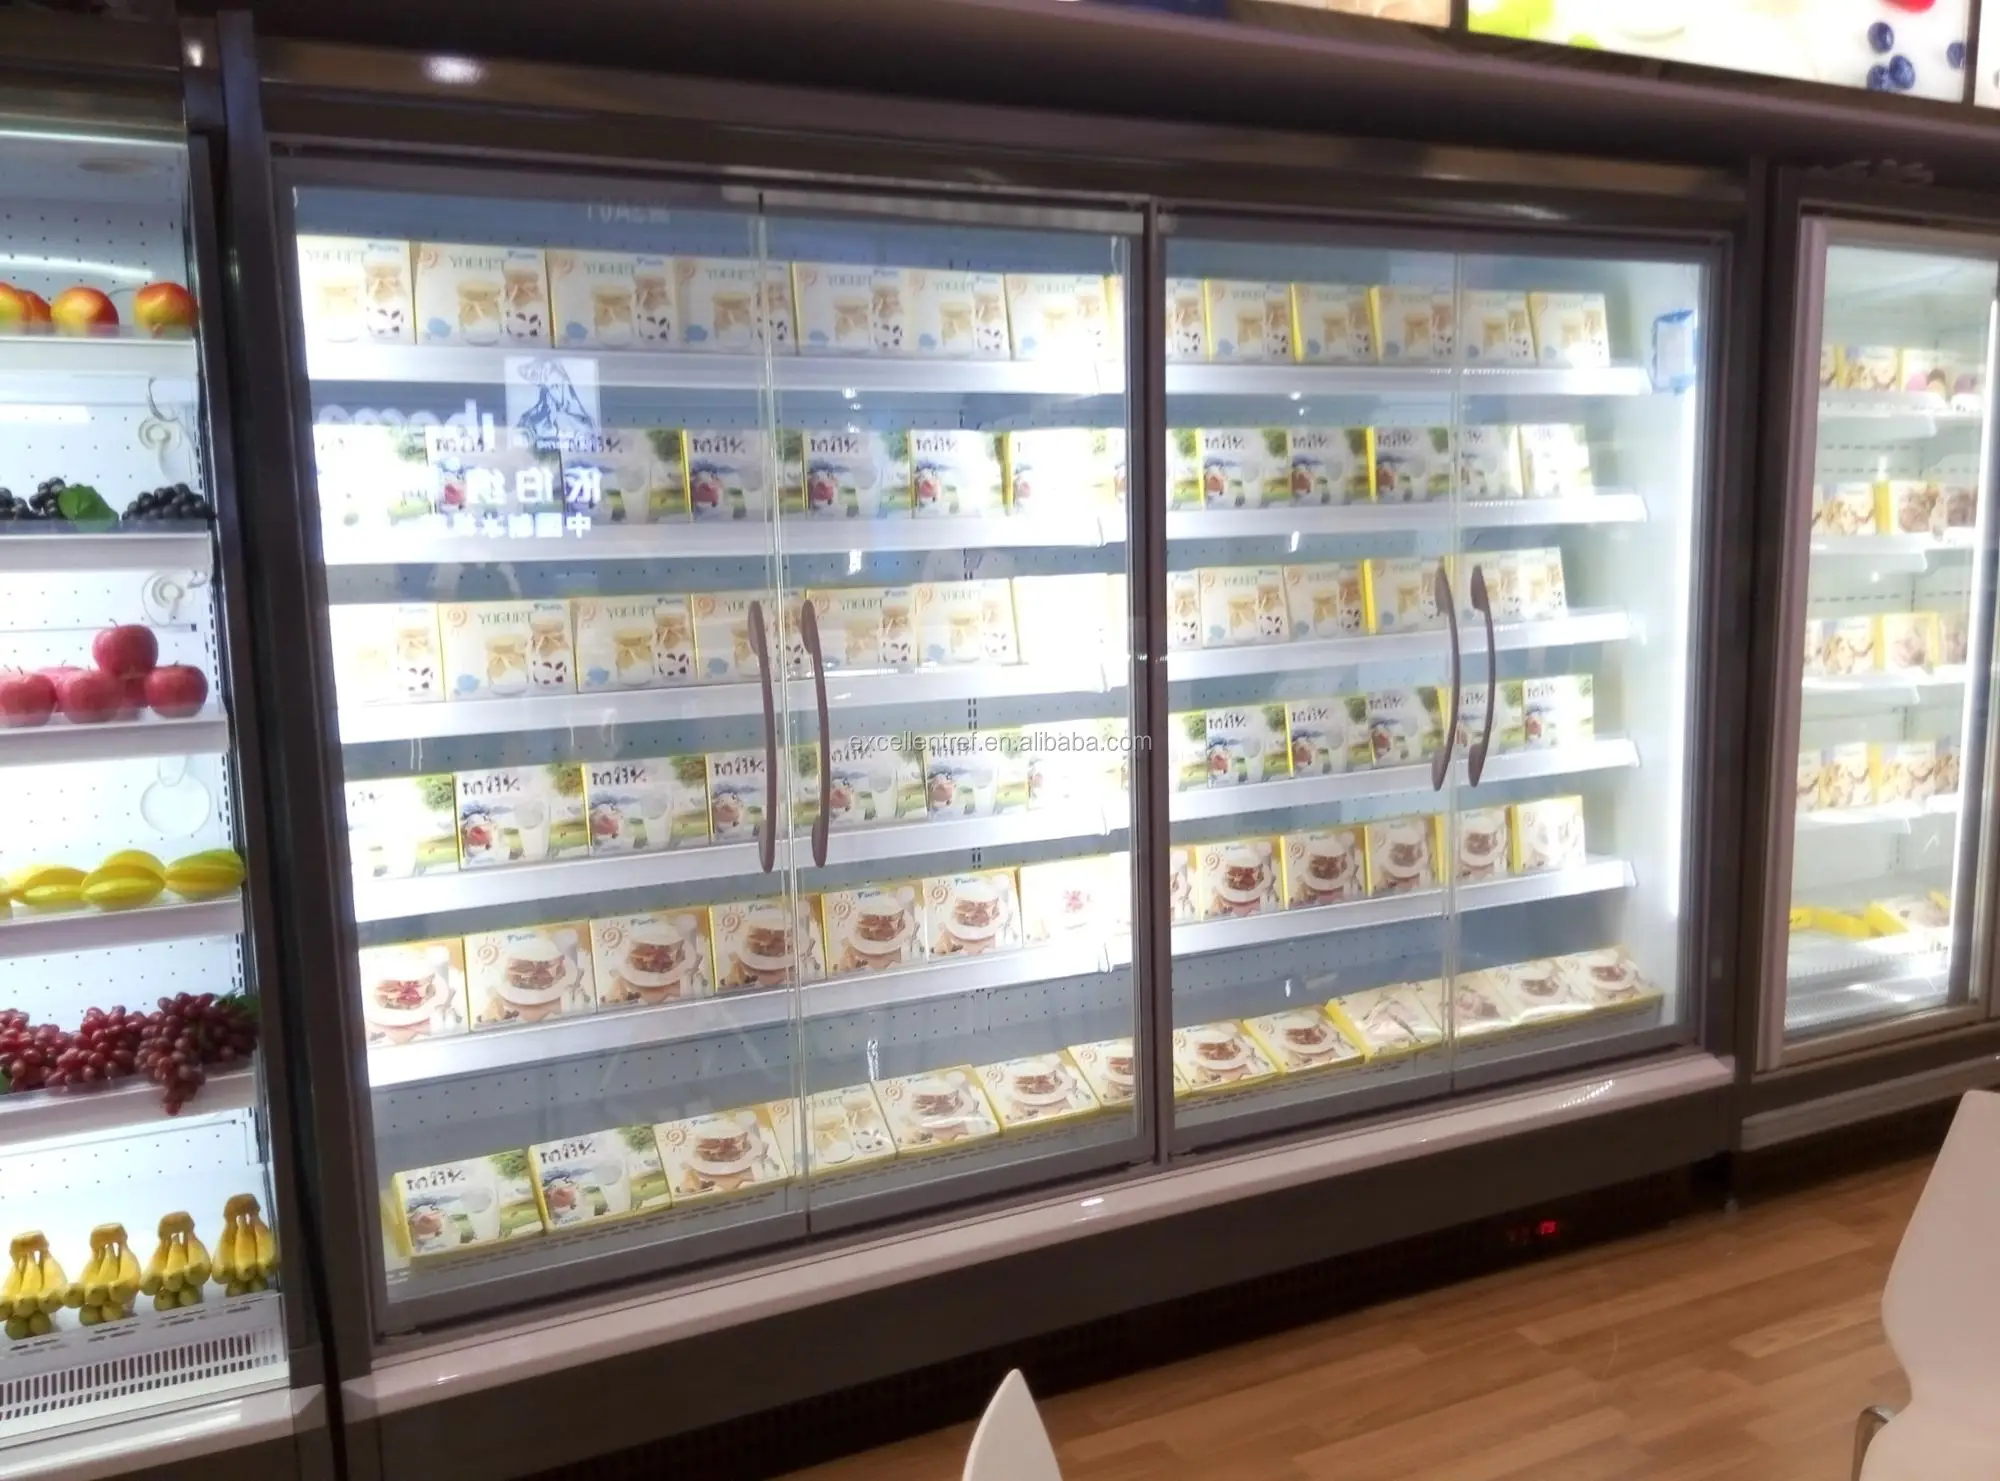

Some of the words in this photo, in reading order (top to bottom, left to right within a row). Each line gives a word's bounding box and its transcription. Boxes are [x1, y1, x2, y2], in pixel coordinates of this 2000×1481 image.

[478, 611, 533, 626] YOGURT
[1208, 711, 1248, 730] milk
[592, 764, 648, 786] milk
[714, 755, 766, 777] milk
[462, 772, 521, 795] milk
[540, 1140, 596, 1165] milk
[406, 1167, 466, 1191] milk
